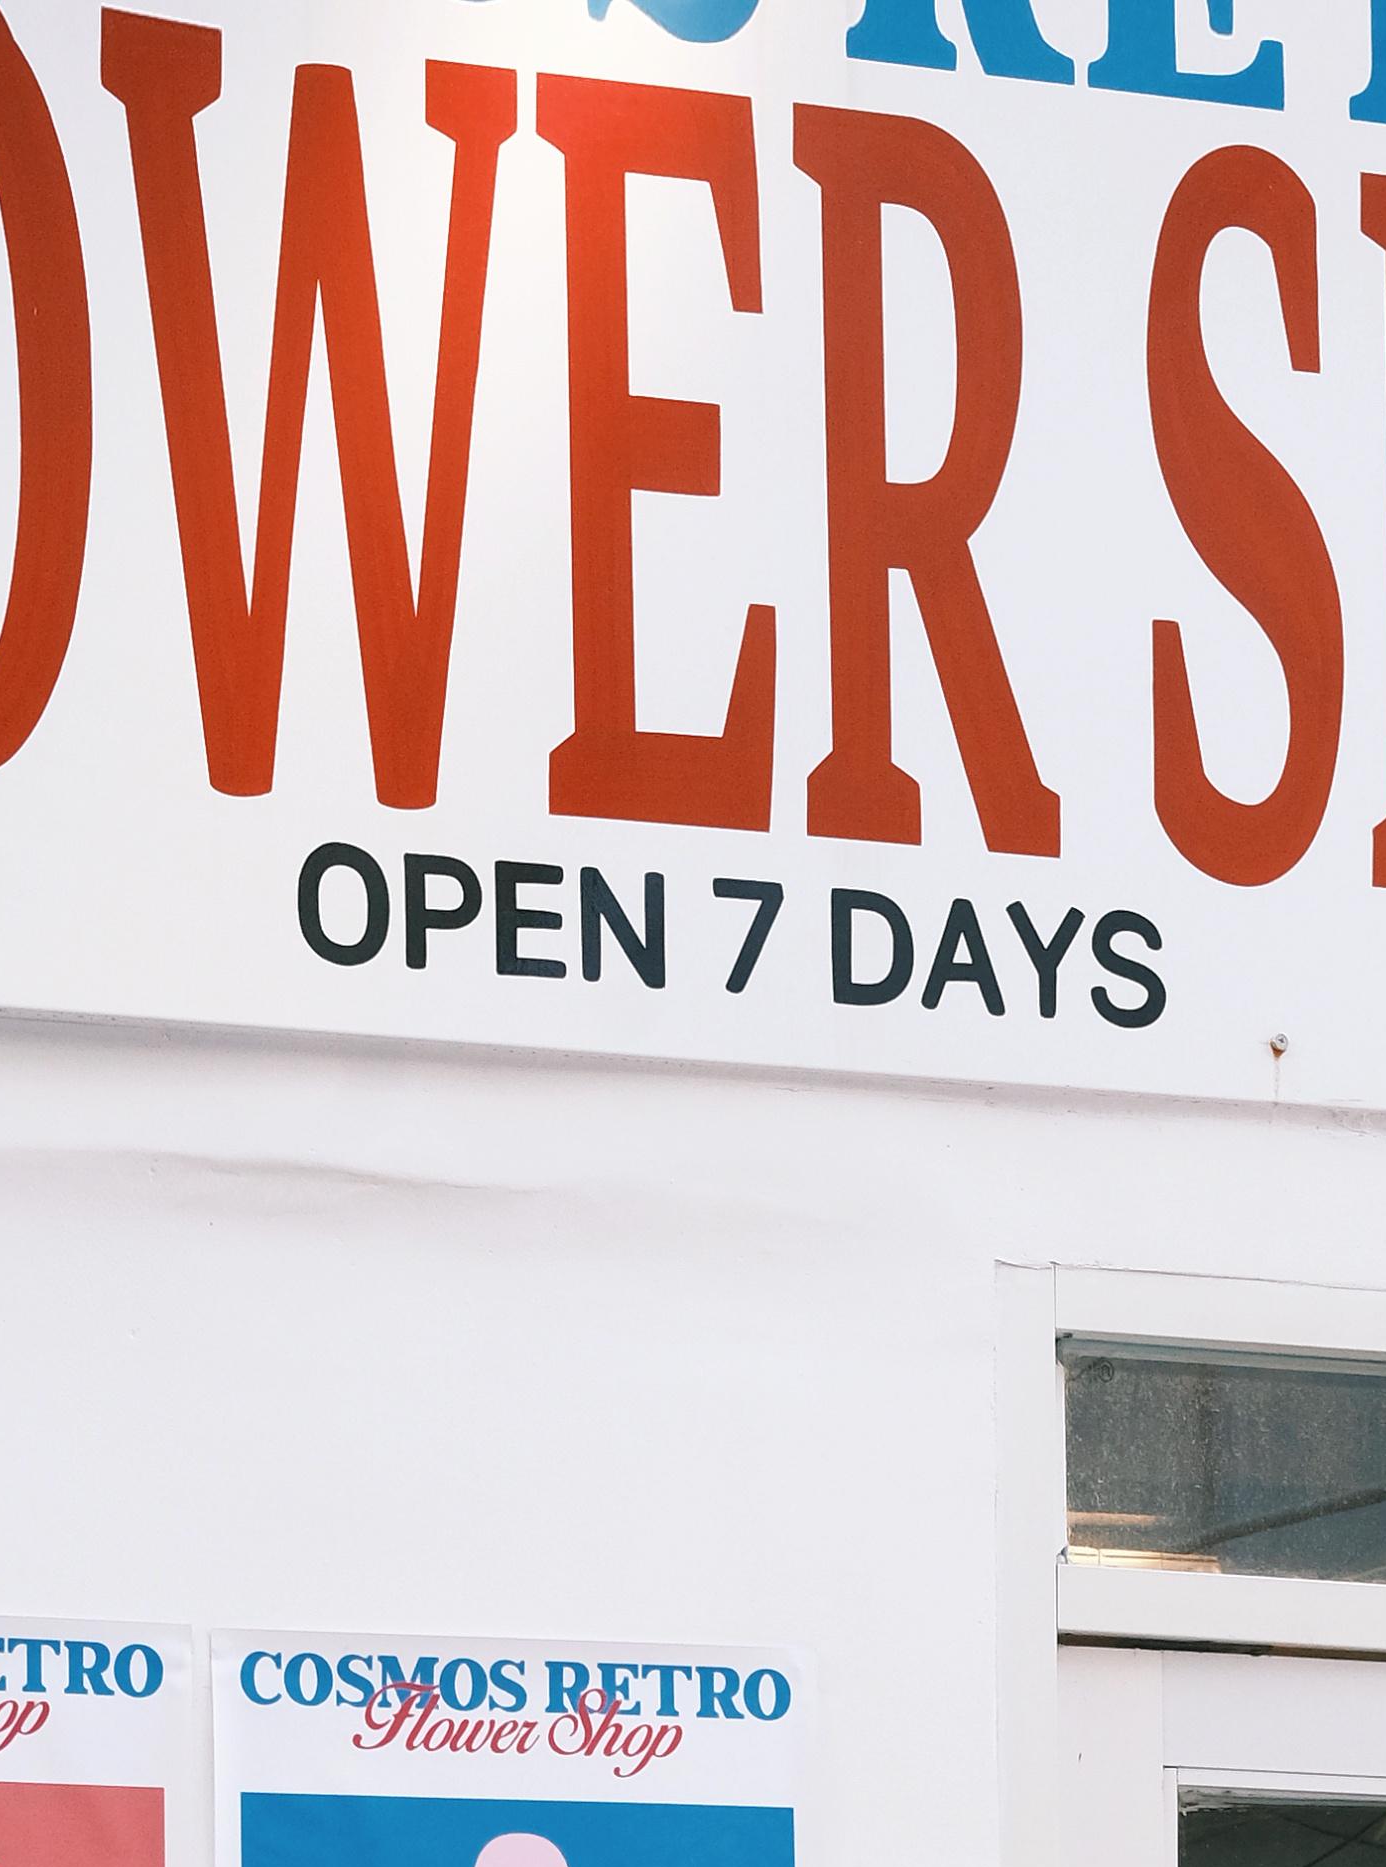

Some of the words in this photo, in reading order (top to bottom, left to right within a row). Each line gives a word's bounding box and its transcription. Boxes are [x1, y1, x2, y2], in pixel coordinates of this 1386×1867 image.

[297, 842, 666, 990] OPEN
[713, 877, 784, 994] 7
[832, 888, 1168, 1030] DAYS
[240, 1651, 527, 1712] COSMOS
[544, 1660, 791, 1721] RETRO
[352, 1682, 537, 1754] Flower
[548, 1688, 683, 1776] Shop
